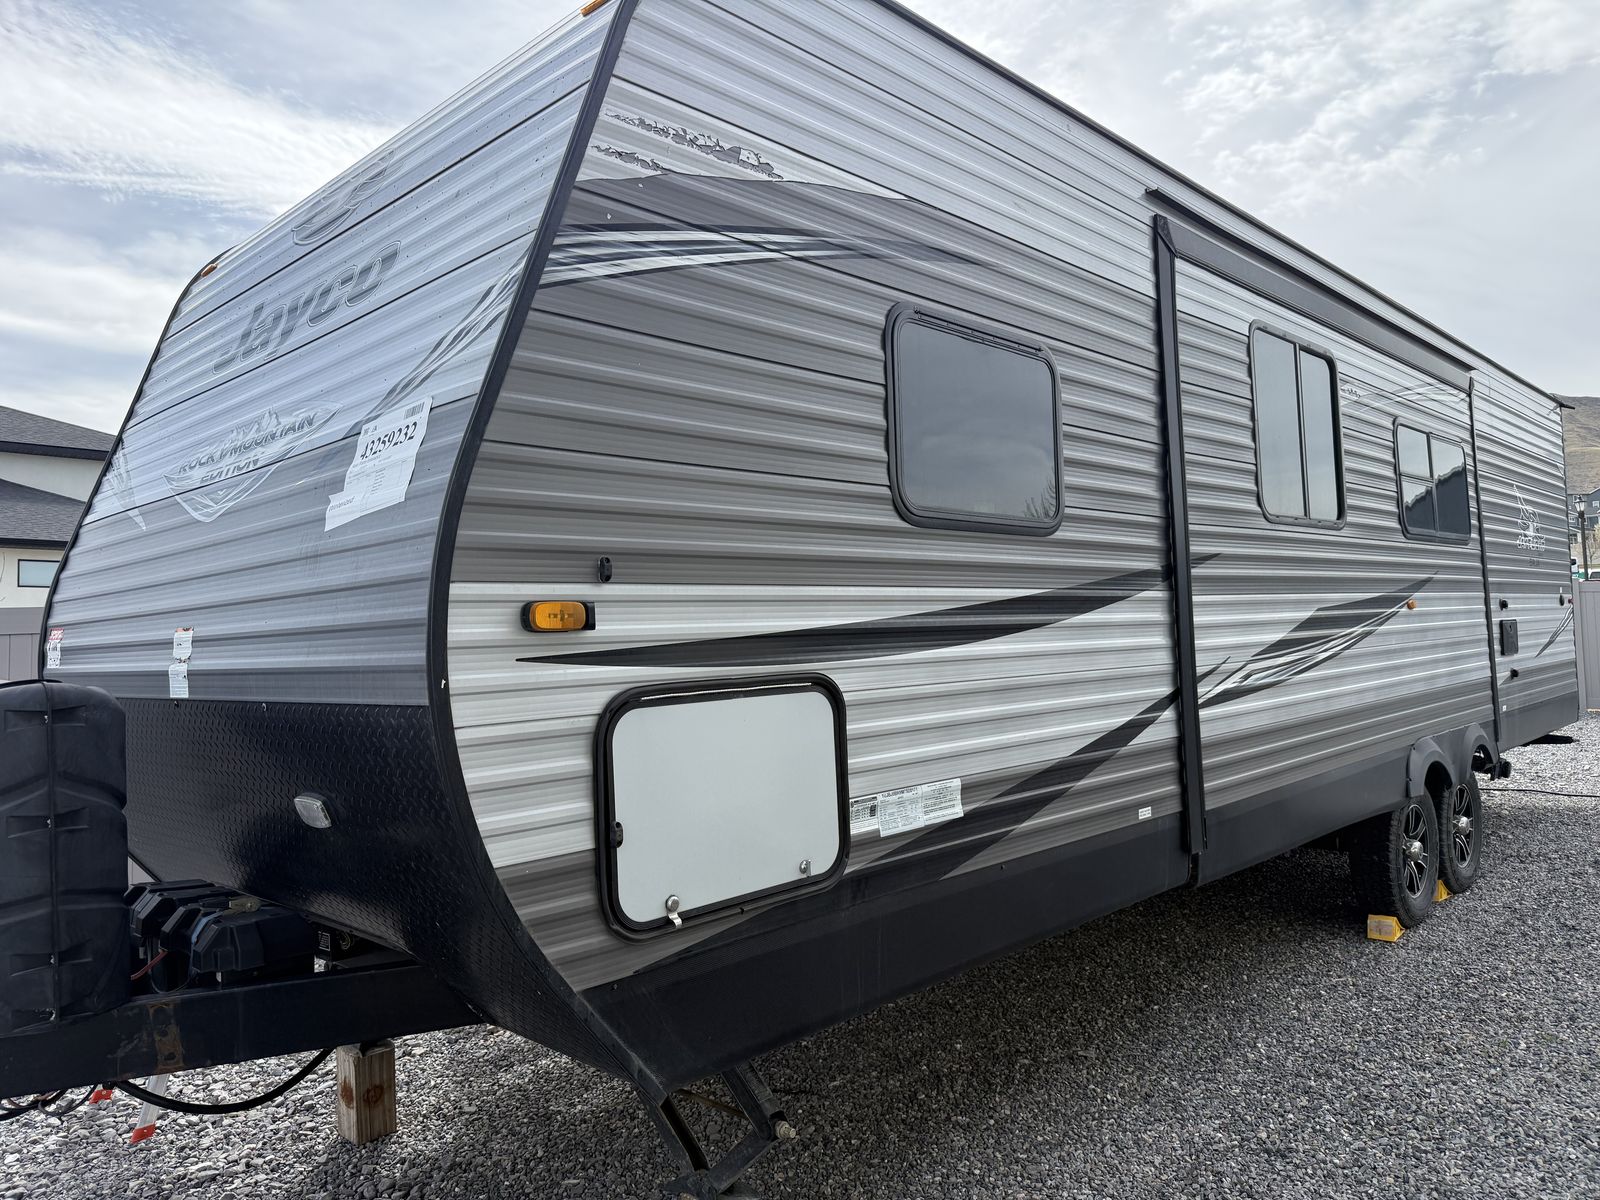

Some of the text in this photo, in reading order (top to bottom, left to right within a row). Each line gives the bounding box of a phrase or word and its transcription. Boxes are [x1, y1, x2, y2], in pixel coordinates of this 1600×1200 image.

[213, 241, 401, 374] Jayco
[229, 411, 319, 457] MOUNTAIN
[360, 421, 418, 460] 43259232
